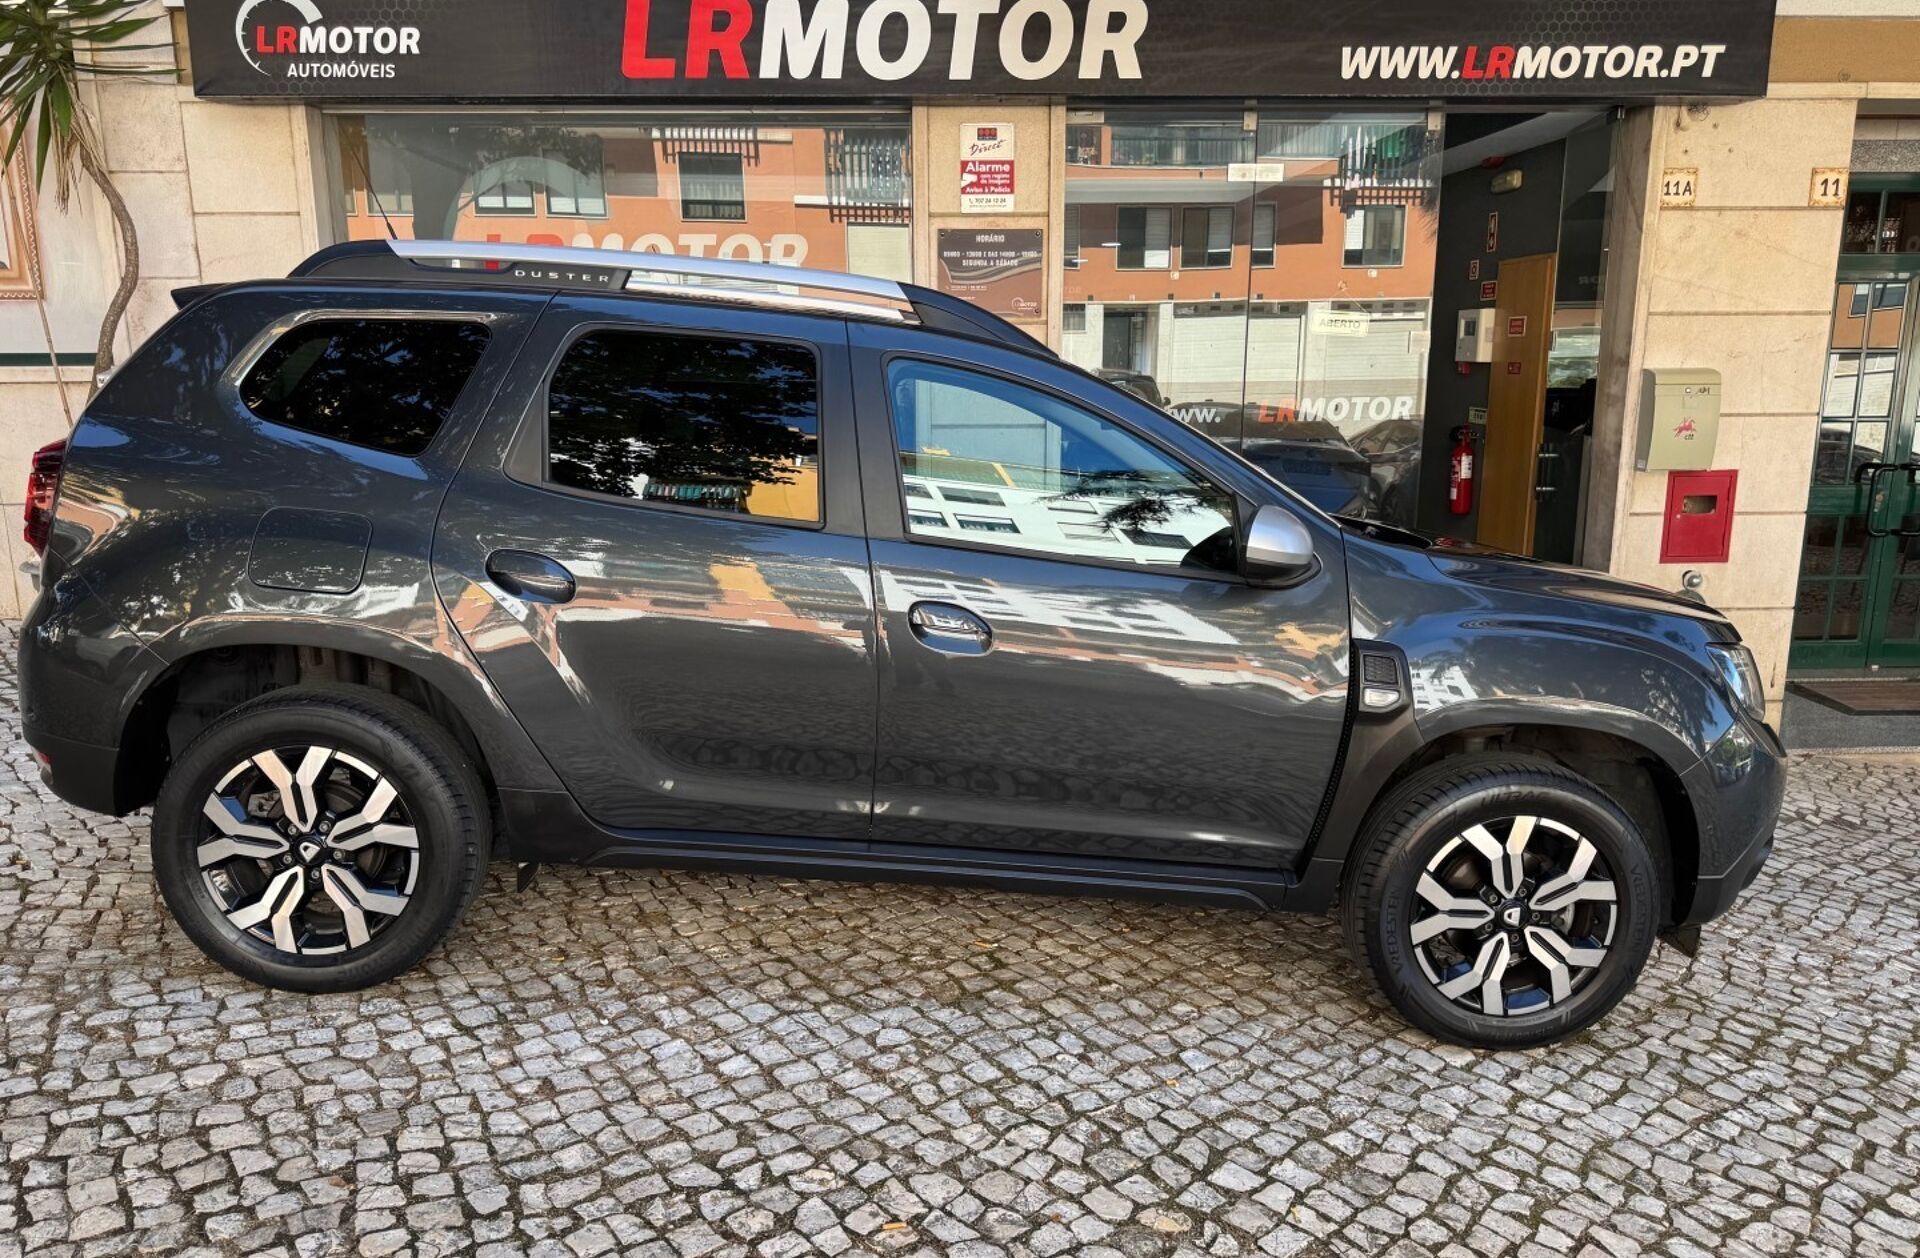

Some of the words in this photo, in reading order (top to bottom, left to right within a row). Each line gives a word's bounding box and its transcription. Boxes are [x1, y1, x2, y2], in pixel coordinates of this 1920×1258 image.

[256, 25, 421, 55] LRMOTOR
[621, 0, 1149, 81] LRMOTOR
[286, 60, 396, 78] AUTOMÓVEIS
[1340, 44, 1726, 80] WWW.LRMOTOR.PT
[968, 140, 1006, 156] Direct
[965, 161, 1010, 172] Alarme
[1663, 181, 1693, 196] 11A
[1820, 178, 1841, 197] 11
[975, 234, 1005, 243] HORÁRIO
[515, 270, 609, 282] DUSTER
[1319, 319, 1361, 329] ABERTO
[1258, 397, 1414, 423] LRMOTOR
